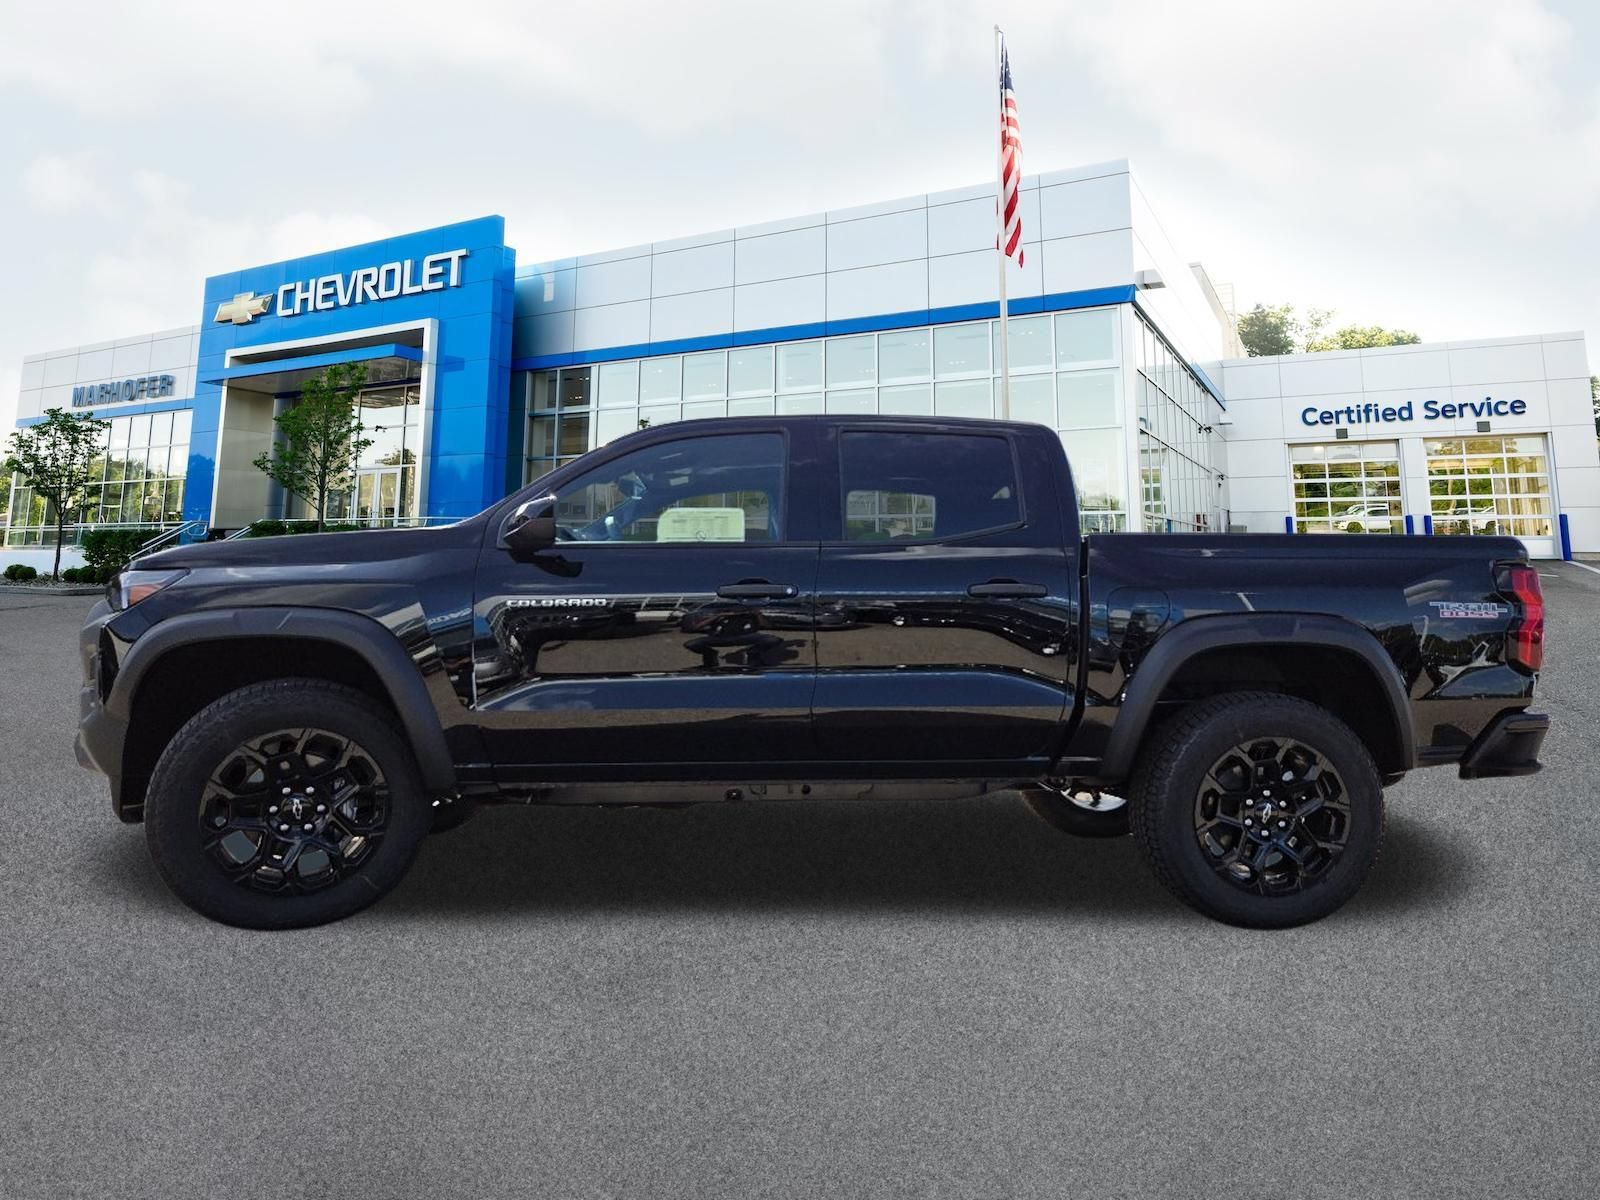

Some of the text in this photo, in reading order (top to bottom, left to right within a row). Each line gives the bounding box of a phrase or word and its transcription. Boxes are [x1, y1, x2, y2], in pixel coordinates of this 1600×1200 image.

[276, 248, 469, 316] CHEVROLET
[72, 374, 175, 407] MARHOFER
[1301, 396, 1527, 426] Certified Service
[506, 598, 607, 608] COLORADO
